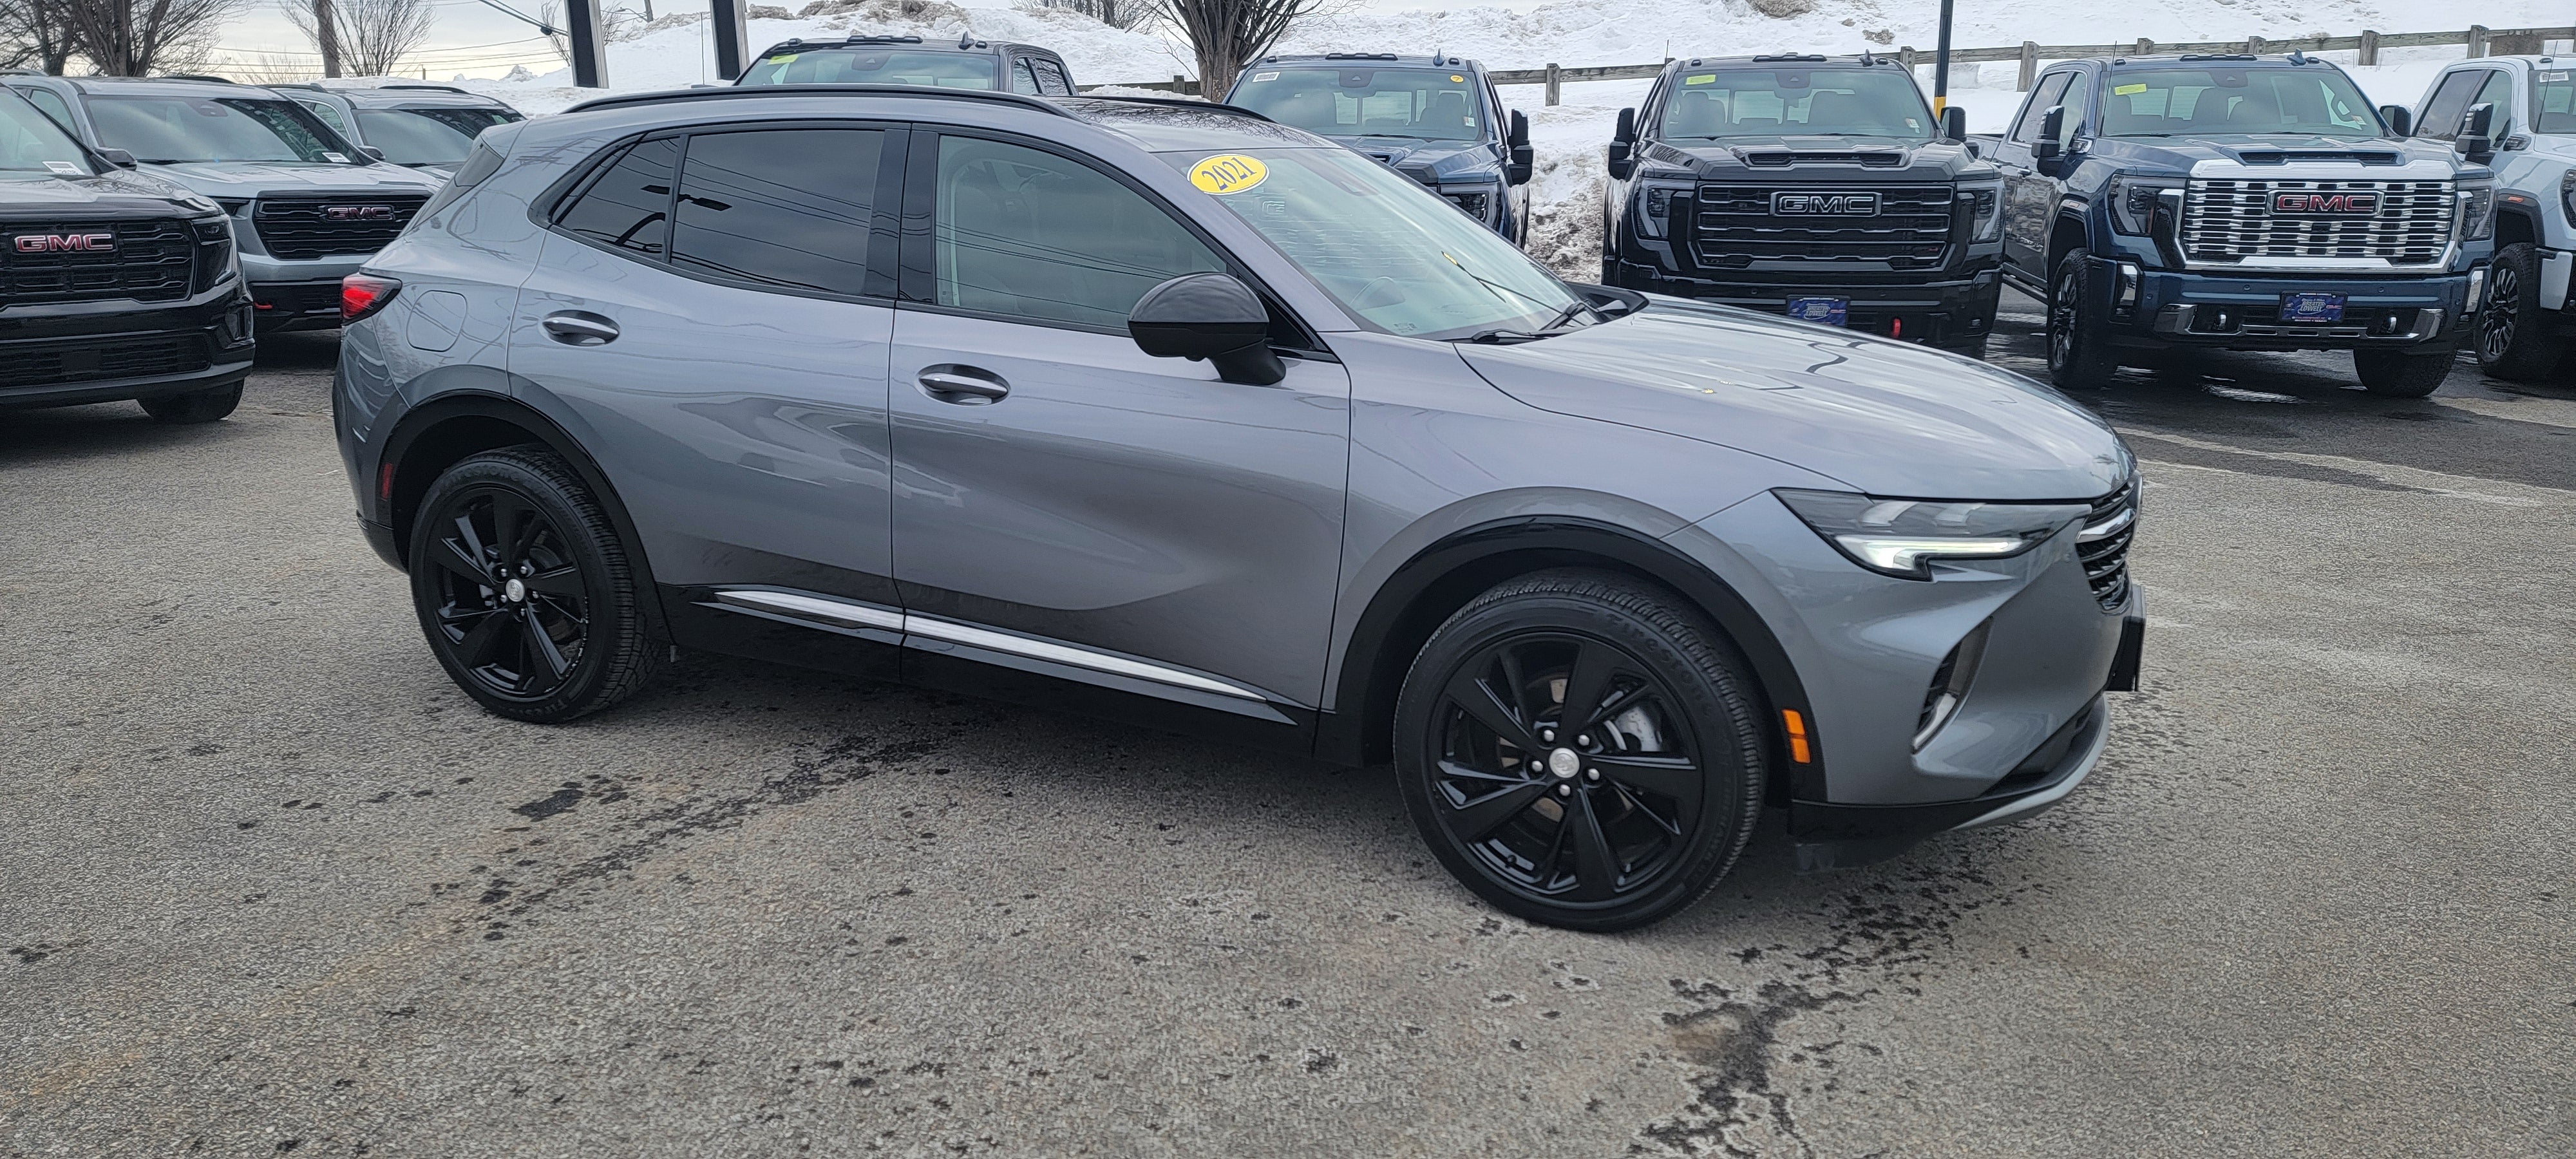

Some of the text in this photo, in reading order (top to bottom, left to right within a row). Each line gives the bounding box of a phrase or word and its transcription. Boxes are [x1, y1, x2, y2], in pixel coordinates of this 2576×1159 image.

[1202, 157, 1257, 191] 2021
[1779, 196, 1874, 213] GMC
[2277, 194, 2376, 212] GMC
[328, 207, 393, 220] GMC
[14, 234, 113, 252] GMC
[1607, 612, 1714, 718] Firestone
